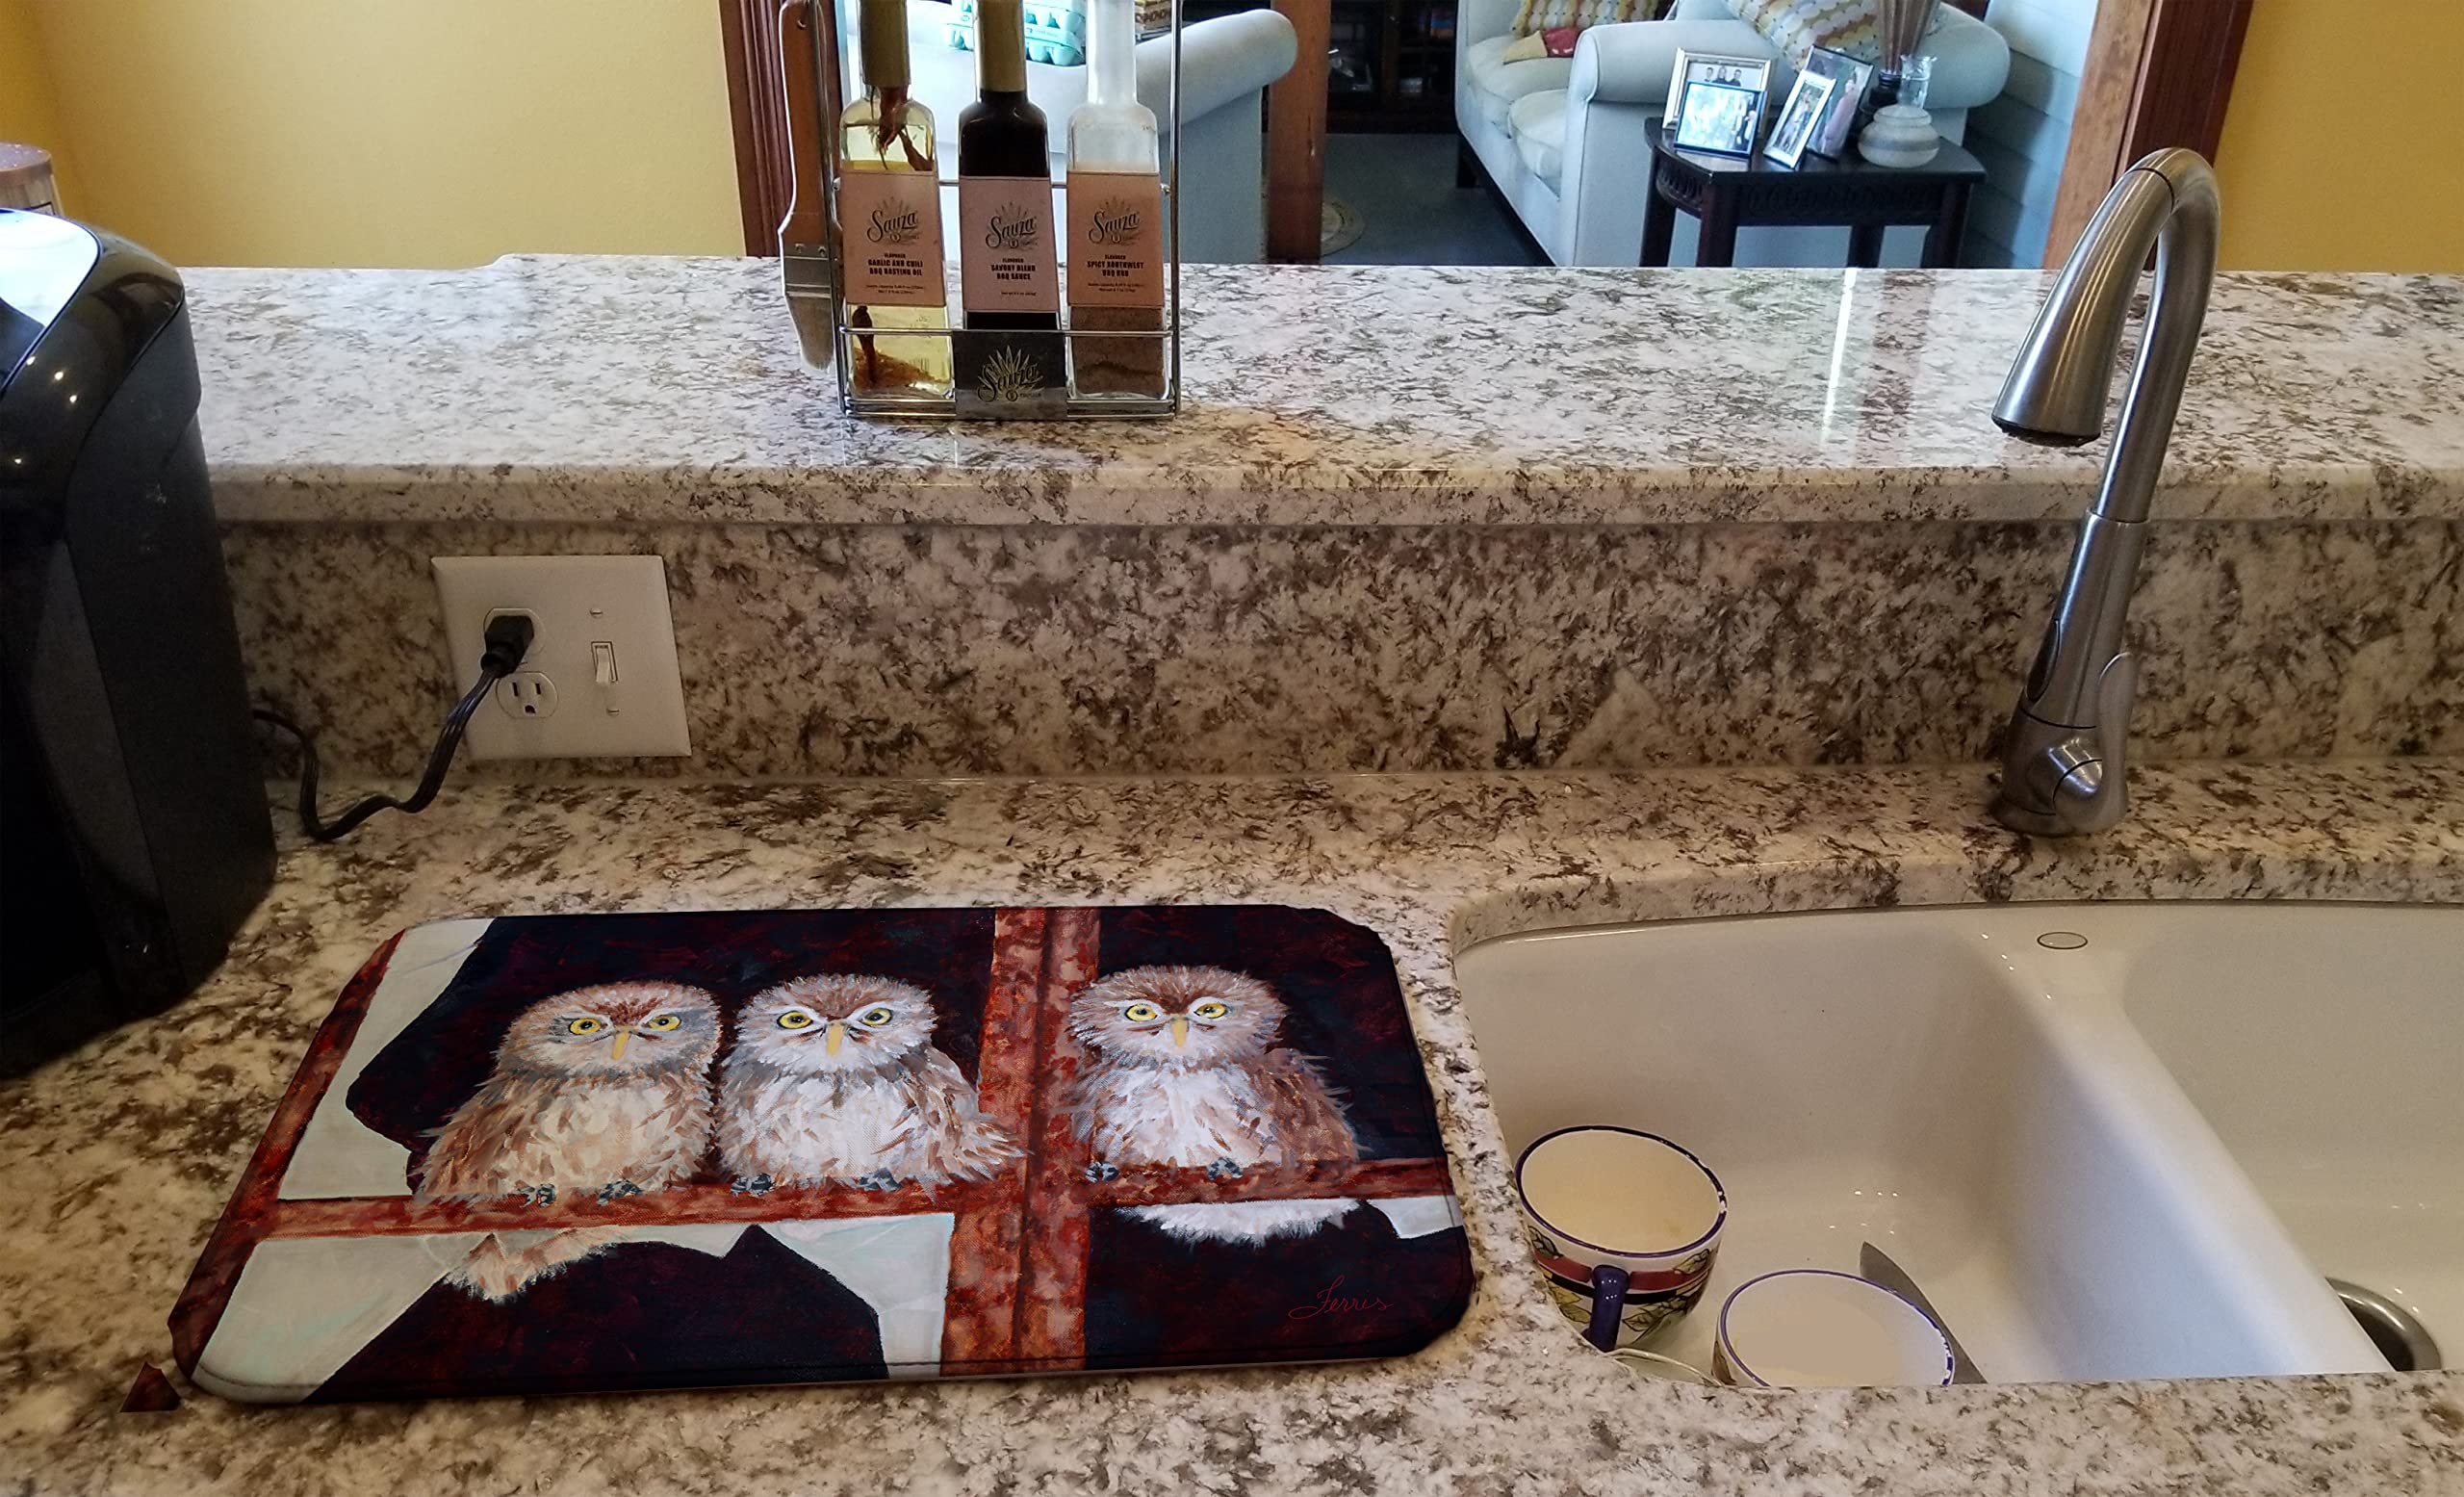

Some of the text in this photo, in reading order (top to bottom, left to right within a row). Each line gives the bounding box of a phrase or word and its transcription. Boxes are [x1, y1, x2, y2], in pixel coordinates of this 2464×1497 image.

[866, 209, 918, 243] Sauza
[985, 215, 1037, 249] Sauza
[1088, 210, 1140, 245] Sauza
[869, 267, 883, 275] BBQ
[912, 268, 923, 276] OIL
[1087, 260, 1144, 270] SPICY SOUTHWEST
[977, 363, 1040, 402] Sauza
